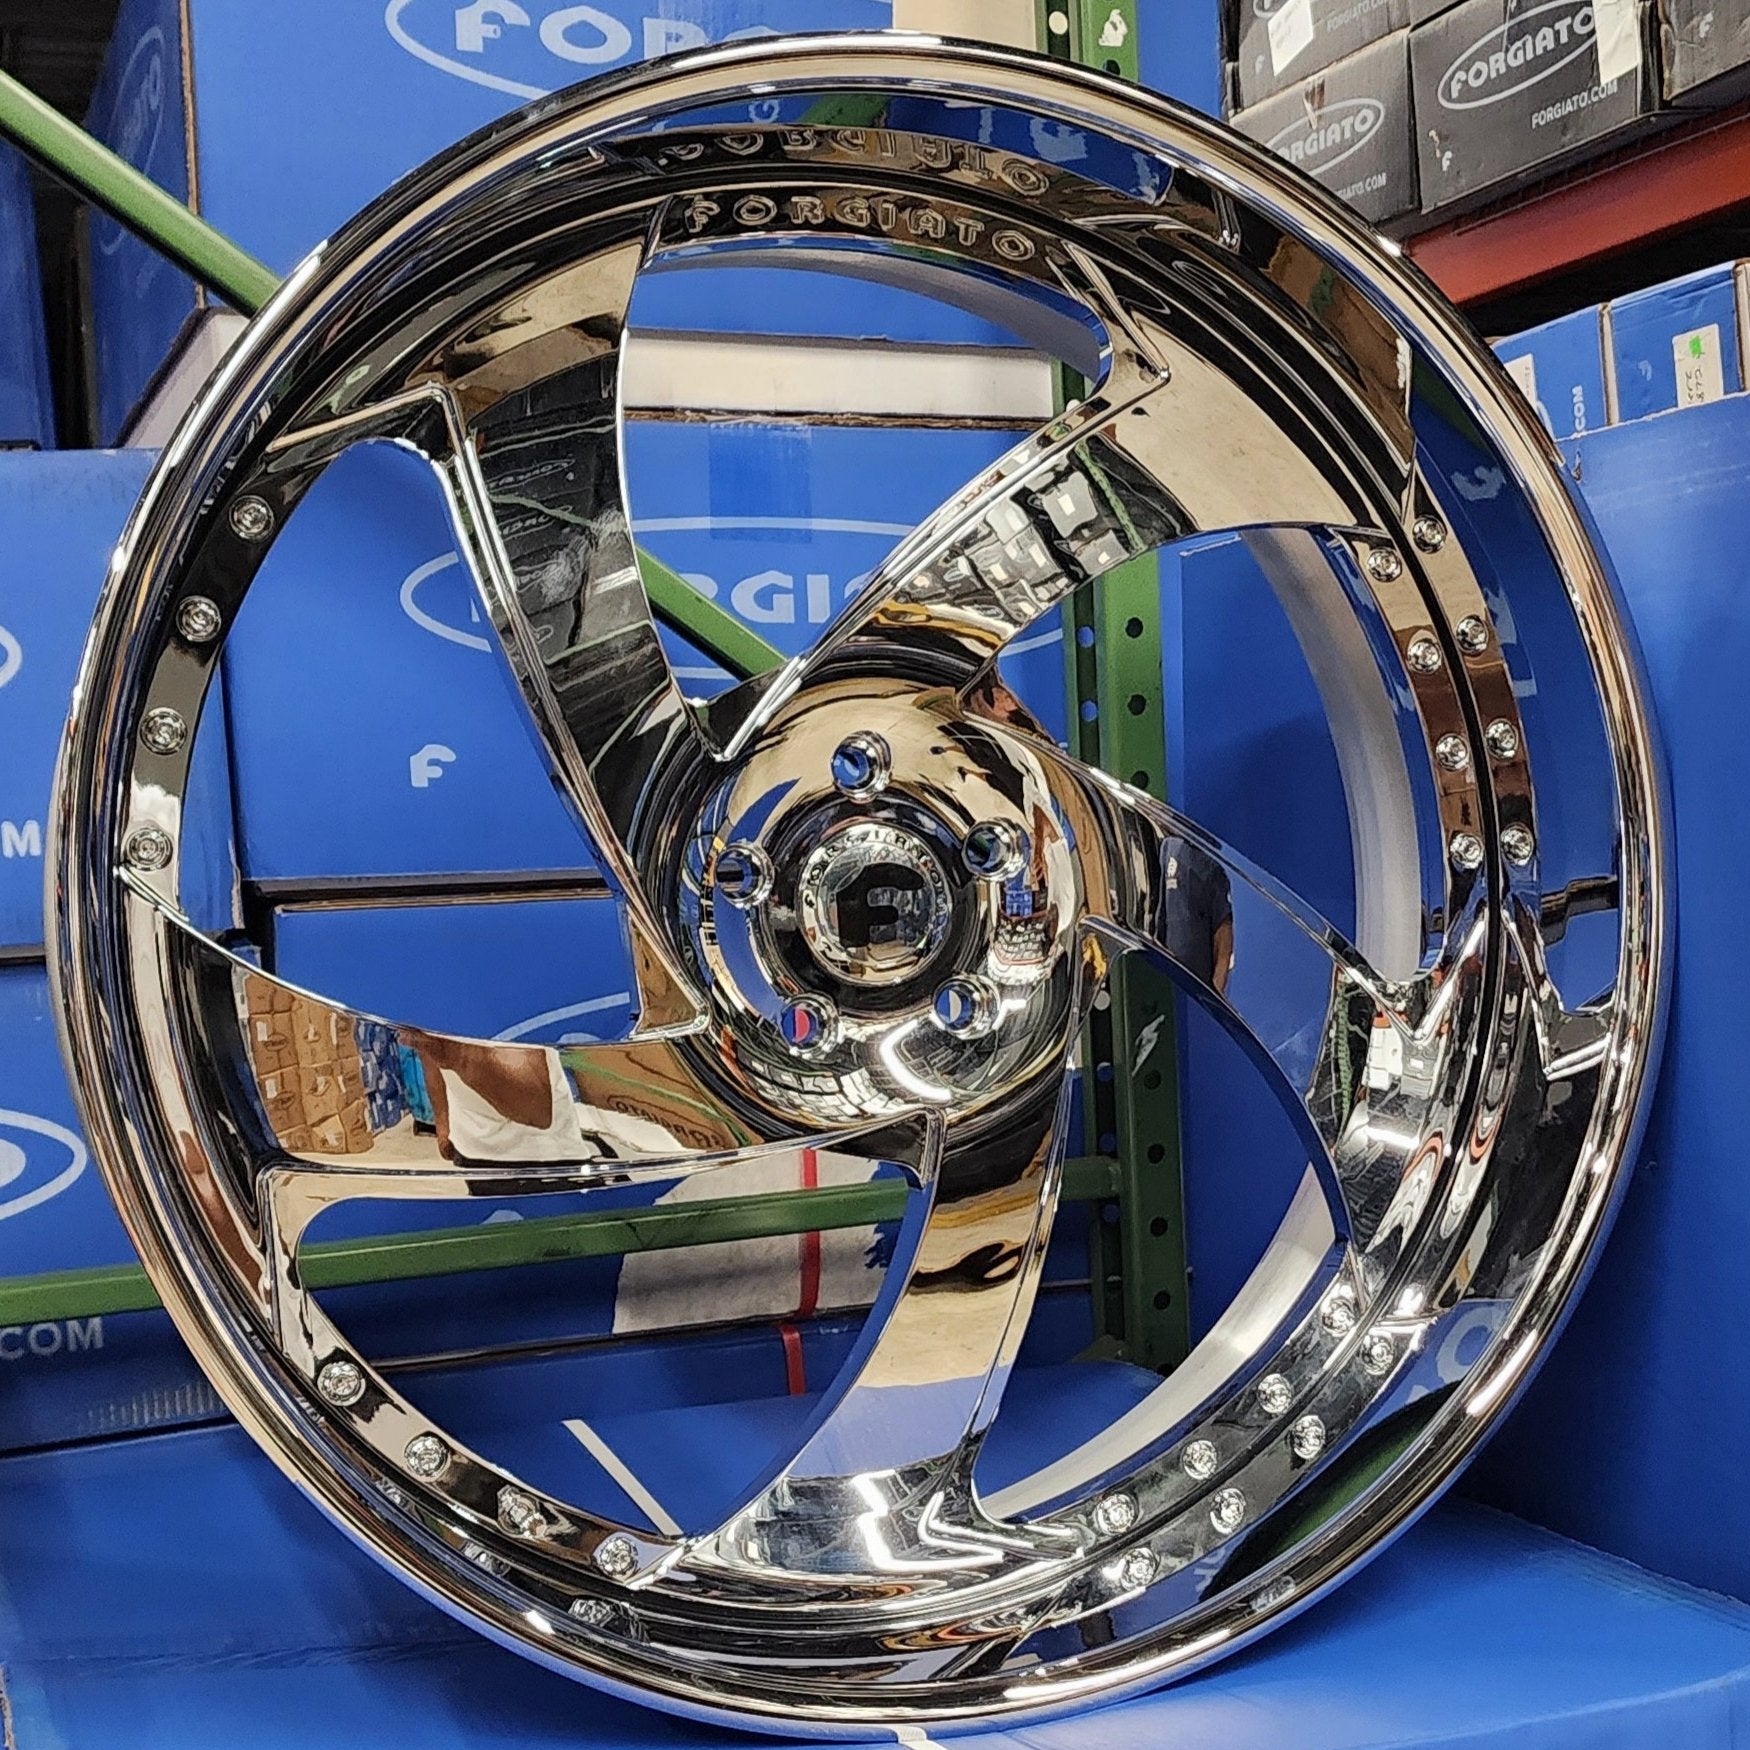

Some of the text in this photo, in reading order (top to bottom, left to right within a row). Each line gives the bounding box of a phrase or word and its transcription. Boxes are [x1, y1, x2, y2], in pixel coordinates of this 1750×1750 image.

[1450, 6, 1595, 100] FORGIATO
[1532, 79, 1618, 129] FORGIATO.COM
[1441, 151, 1452, 172] F
[684, 194, 1035, 261] FORGIATO
[410, 744, 456, 787] F
[836, 862, 924, 947] F
